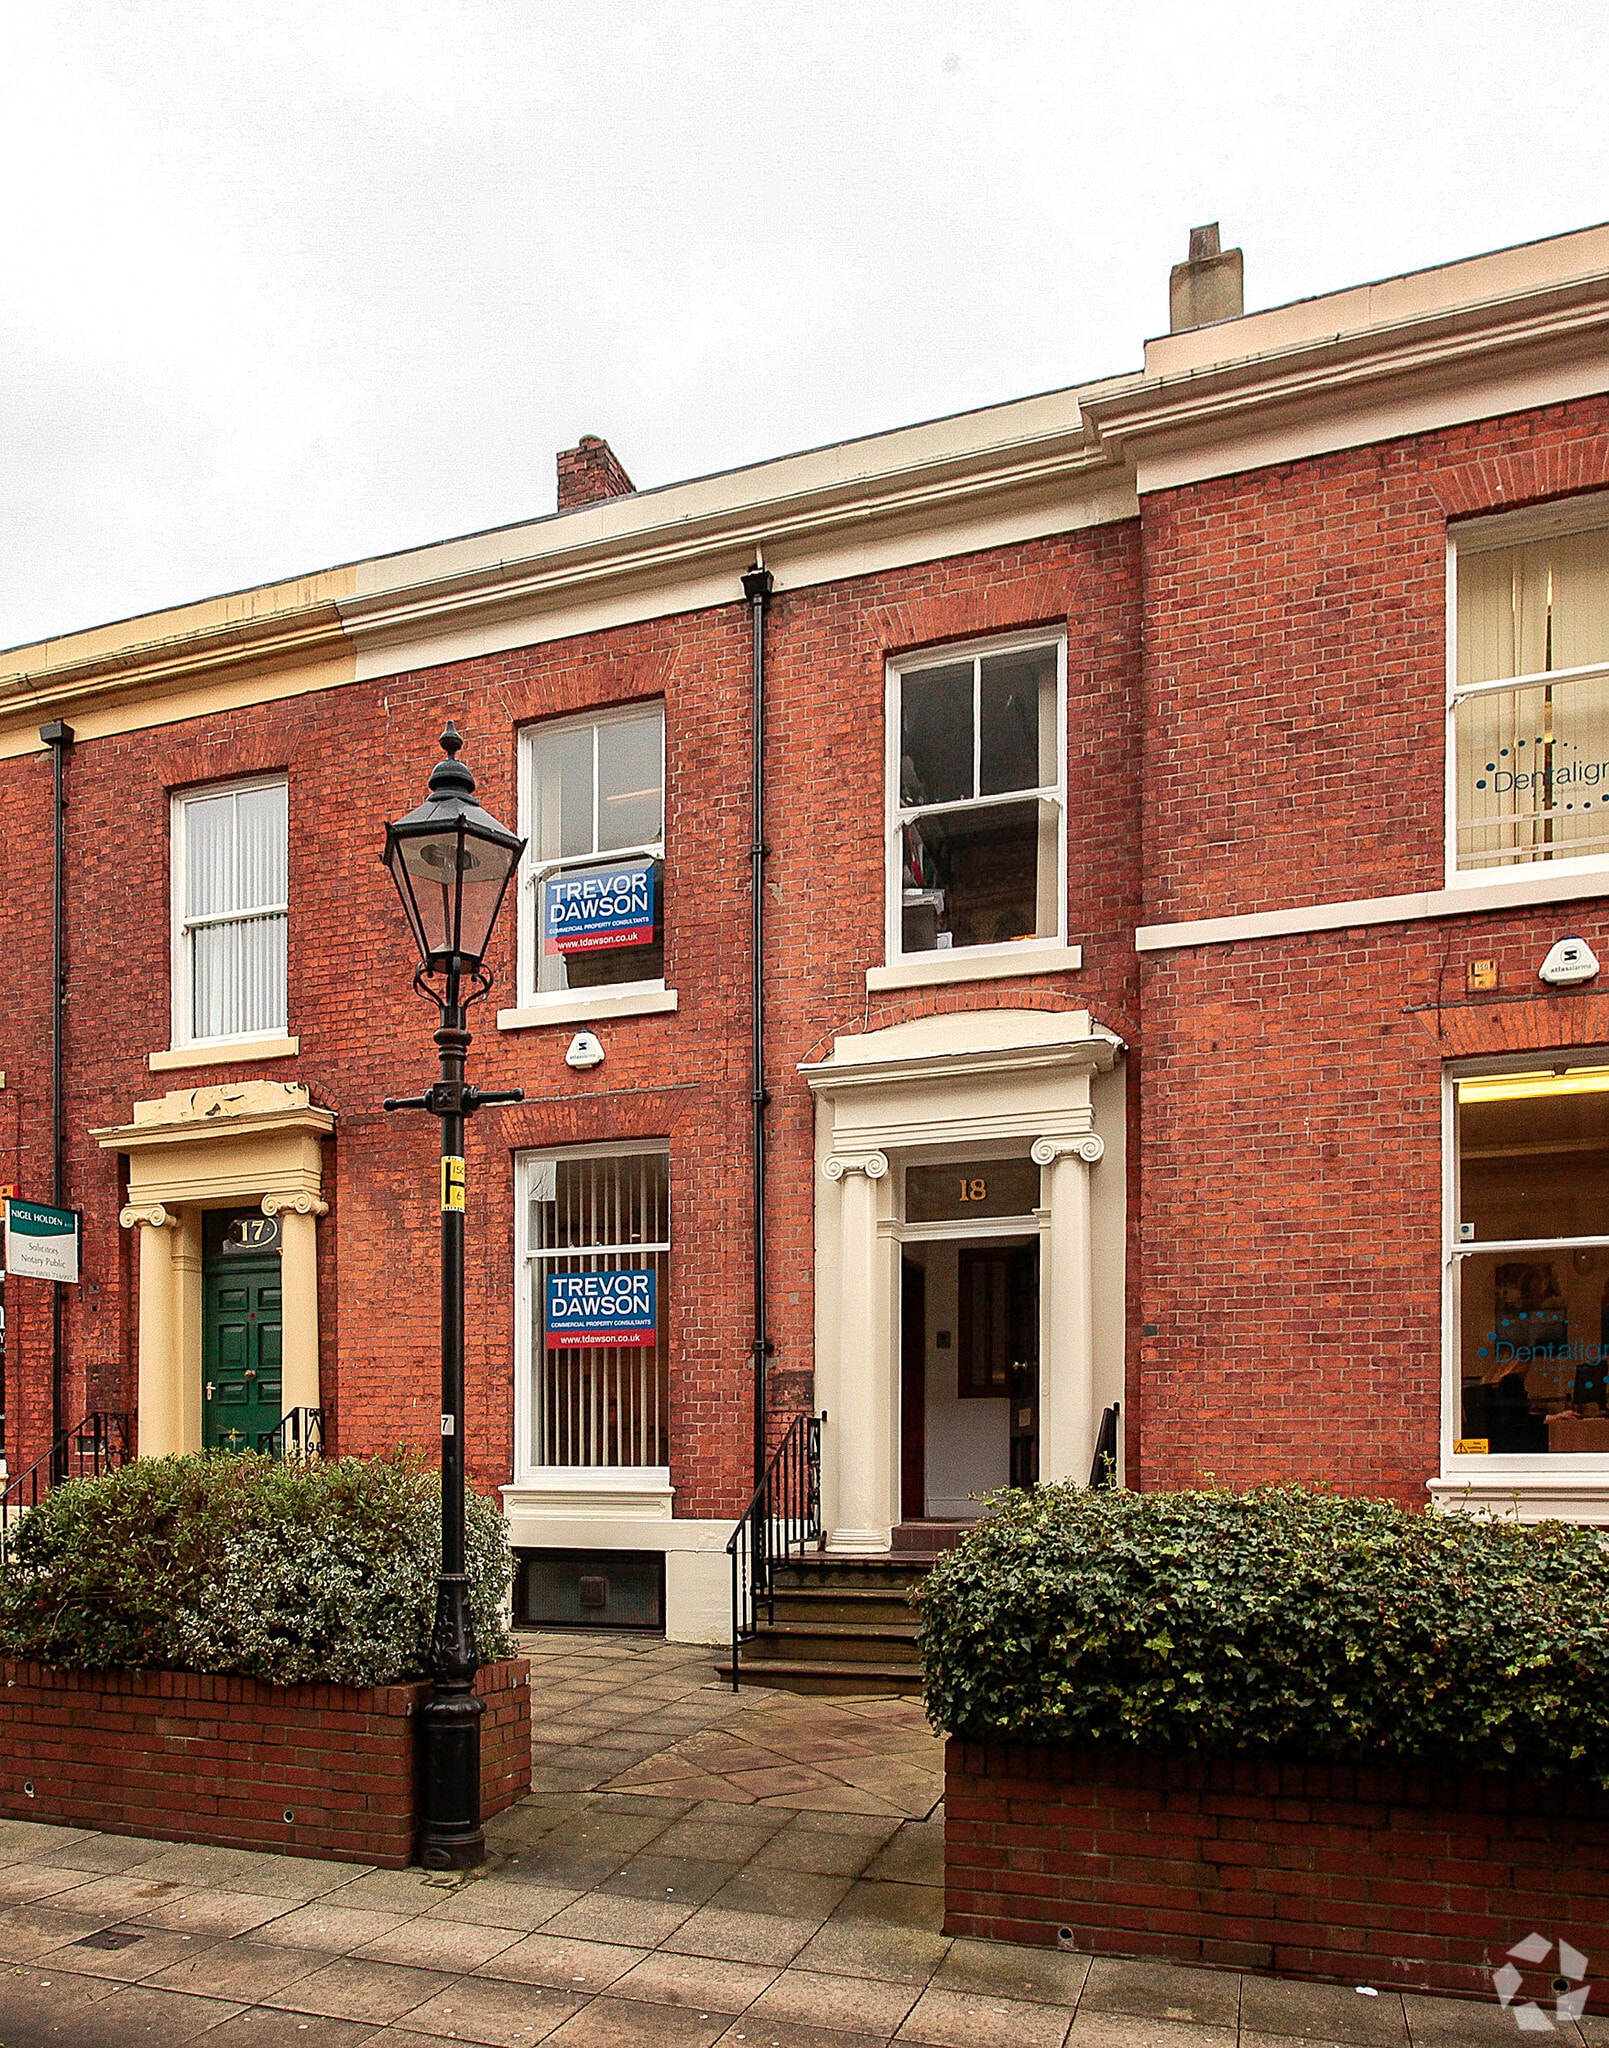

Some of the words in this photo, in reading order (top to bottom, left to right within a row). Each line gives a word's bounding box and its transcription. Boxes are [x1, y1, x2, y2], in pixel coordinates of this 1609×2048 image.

[551, 873, 647, 902] TREVOR
[550, 892, 648, 923] DAWSON
[548, 925, 583, 935] COMMERCIAL
[584, 920, 611, 930] PROPERTY
[612, 916, 649, 926] CONSULTANTS
[559, 931, 638, 950] www.tdawson.co.uk
[456, 1191, 463, 1201] 6
[960, 1179, 987, 1201] 18
[11, 1208, 32, 1221] NIGEL
[33, 1213, 63, 1226] HOLDEN
[241, 1220, 265, 1241] 17
[28, 1242, 59, 1255] Solicitors
[21, 1254, 44, 1267] Notary
[45, 1257, 66, 1269] Public
[552, 1275, 648, 1296] TREVOR
[552, 1295, 649, 1317] DAWSON
[560, 1334, 640, 1344] www.tdawson.co.uk
[442, 1417, 449, 1431] 7
